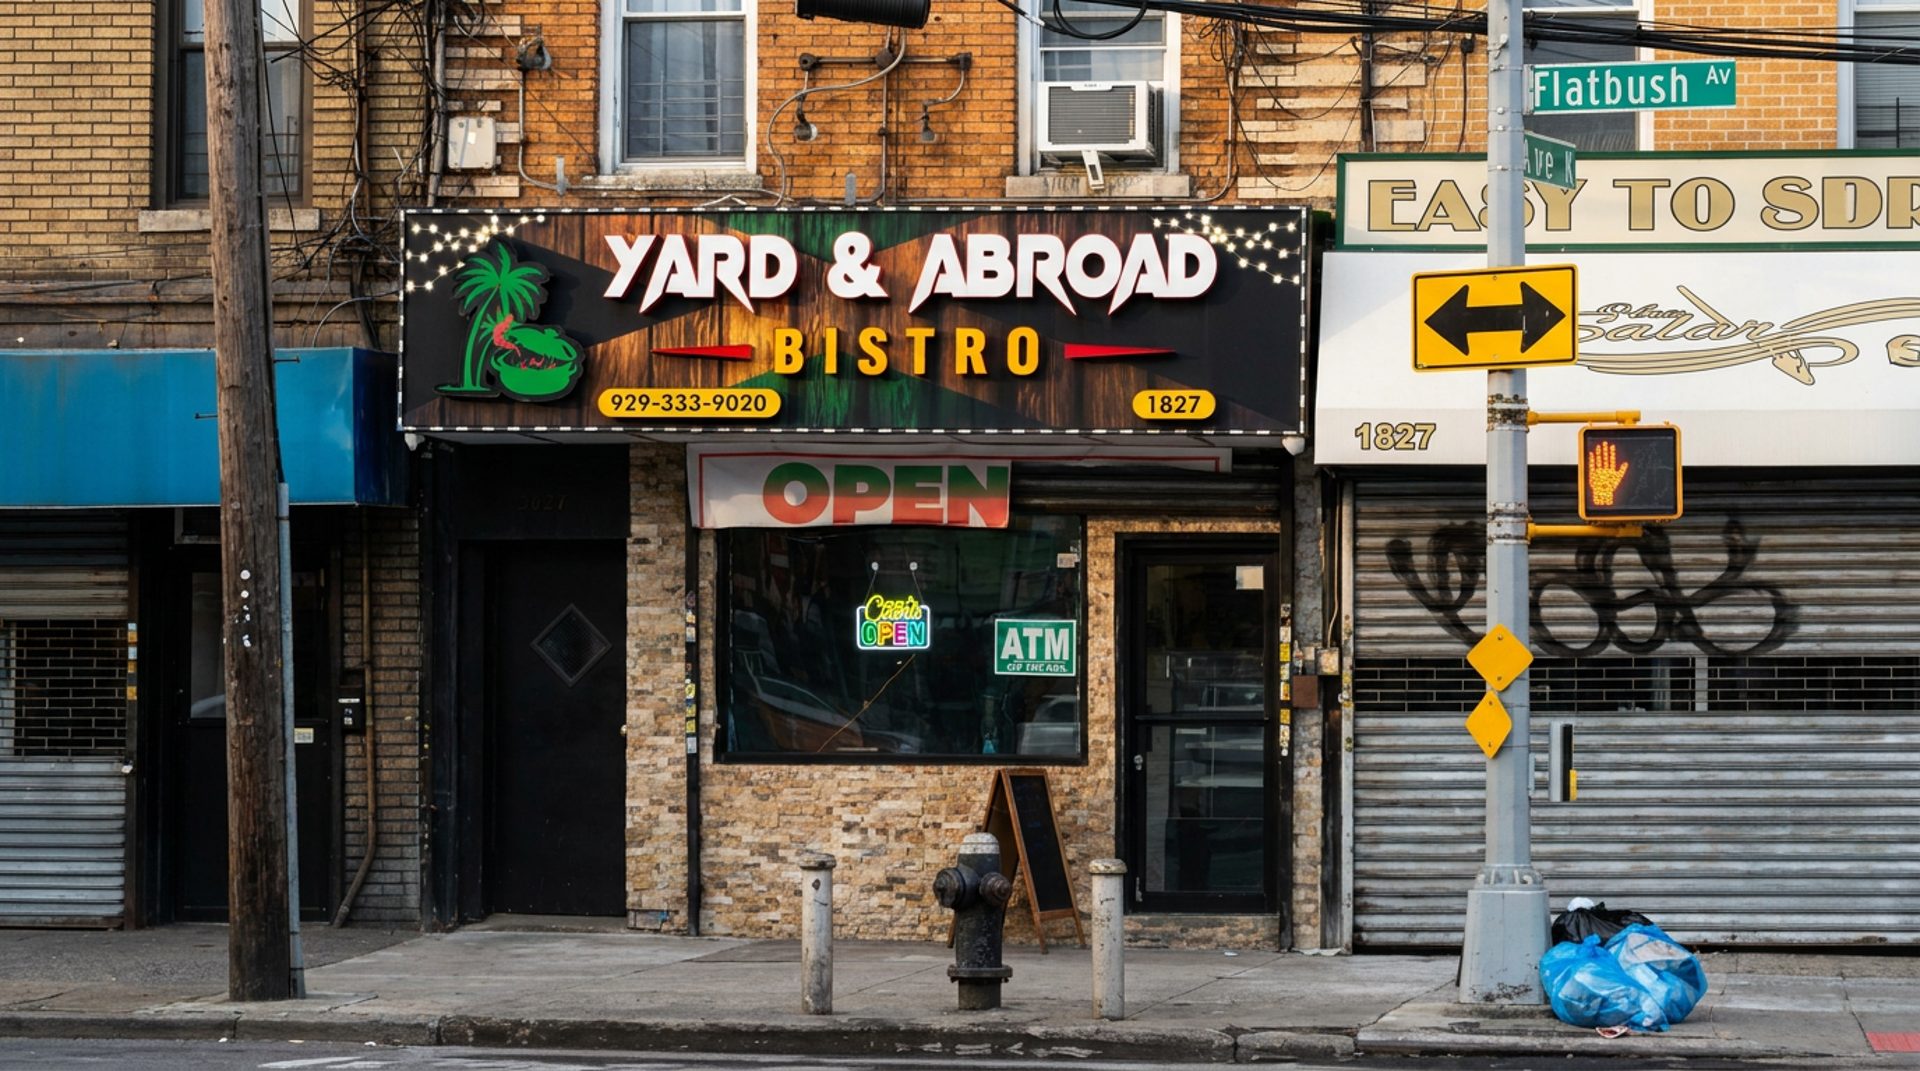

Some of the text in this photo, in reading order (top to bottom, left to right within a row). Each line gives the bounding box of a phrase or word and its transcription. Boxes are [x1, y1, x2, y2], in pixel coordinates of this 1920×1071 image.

[1535, 65, 1731, 107] Flatbush Av
[1564, 150, 1575, 187] K
[1613, 177, 1736, 231] TO
[603, 231, 1218, 316] YARD & ABROAD
[774, 326, 1039, 376] BISTRO
[611, 393, 767, 412] 929-333-9020
[1148, 395, 1201, 413] 1827
[1355, 422, 1436, 450] 1827
[763, 462, 1009, 528] OPEN
[861, 620, 926, 646] OPEN
[1000, 627, 1070, 660] ATM
